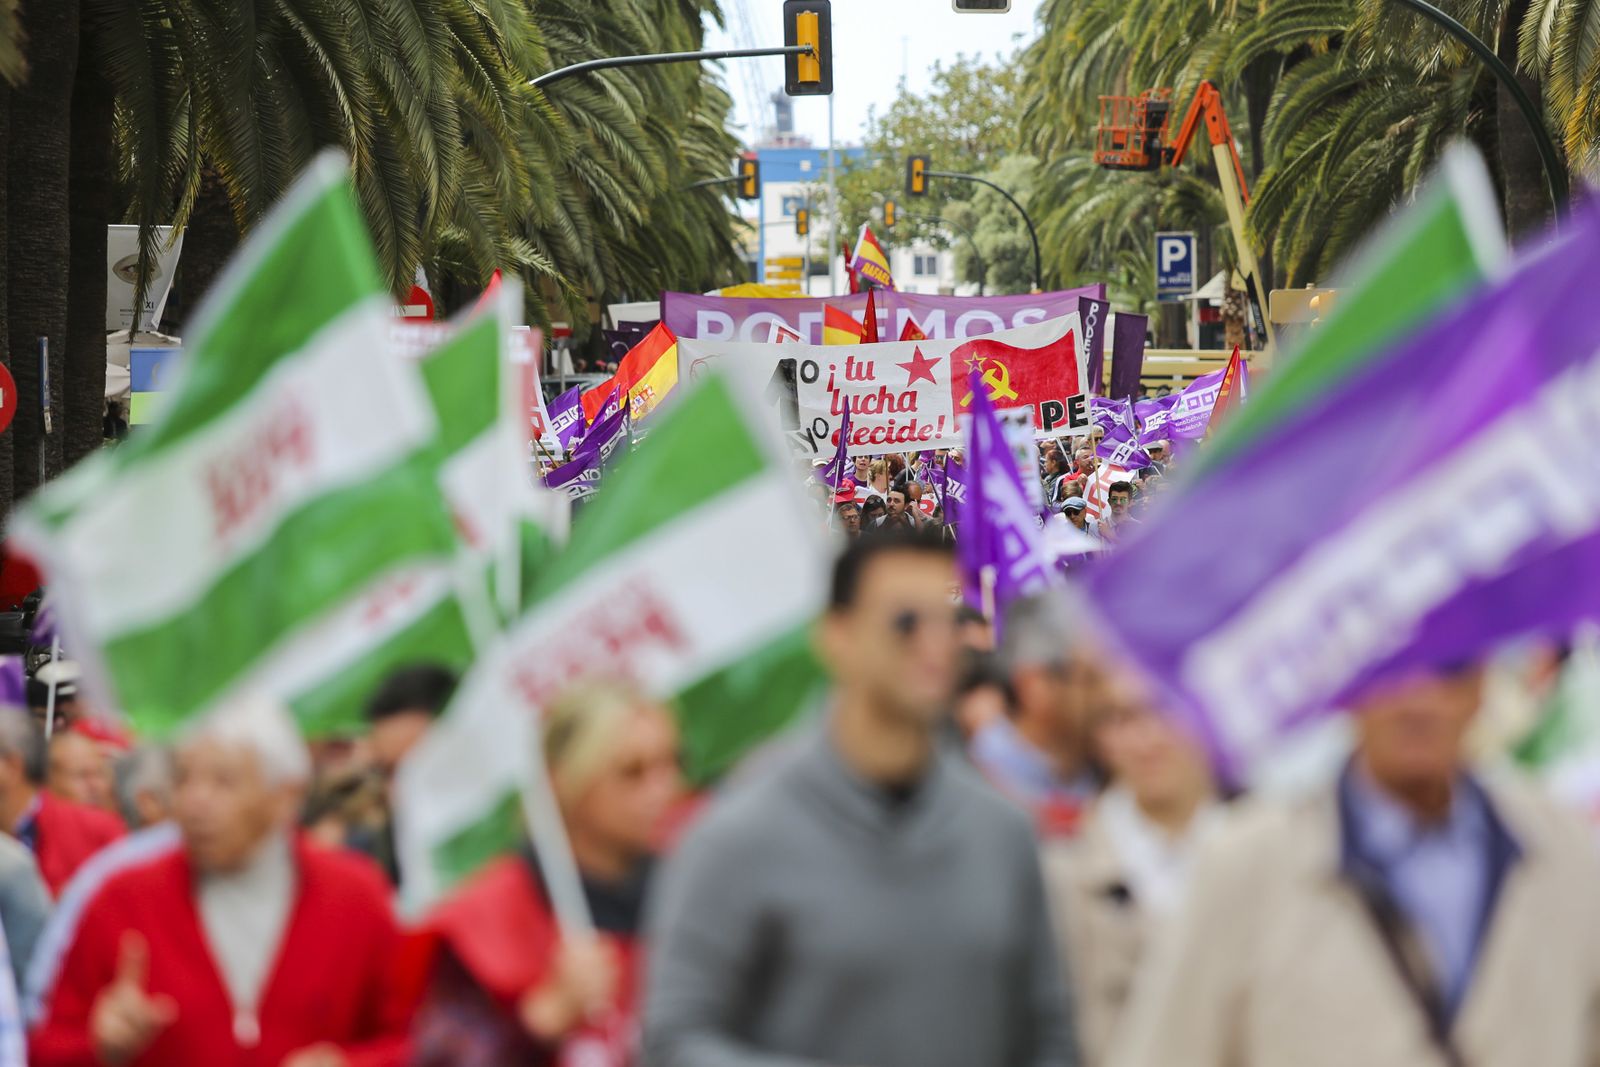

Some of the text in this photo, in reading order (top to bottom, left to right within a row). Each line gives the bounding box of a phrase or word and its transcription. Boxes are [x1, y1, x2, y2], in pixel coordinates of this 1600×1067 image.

[1162, 239, 1187, 272] P
[830, 385, 918, 416] lucha
[1031, 394, 1089, 433] PE
[831, 415, 946, 447] decide!
